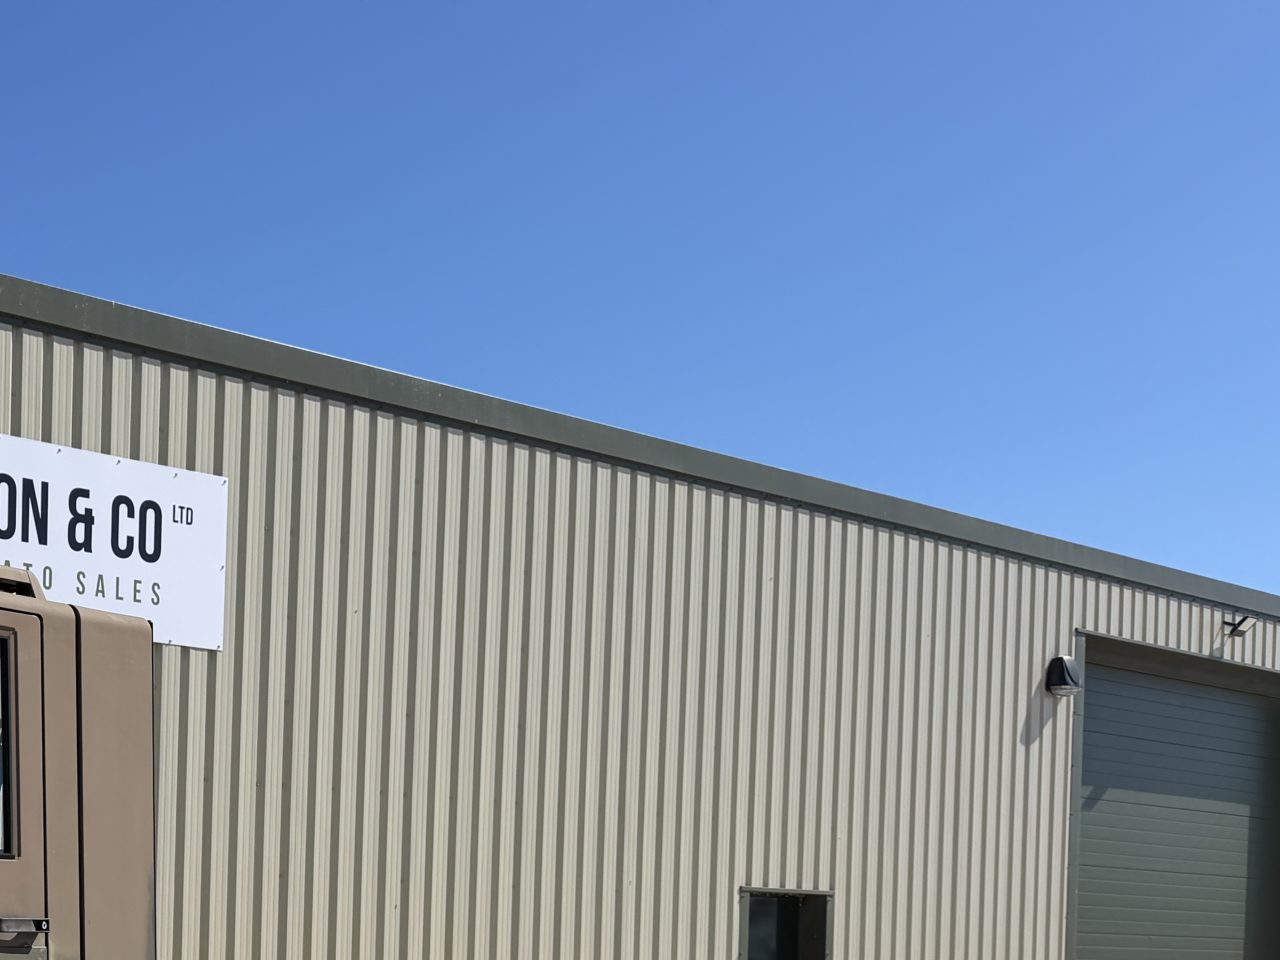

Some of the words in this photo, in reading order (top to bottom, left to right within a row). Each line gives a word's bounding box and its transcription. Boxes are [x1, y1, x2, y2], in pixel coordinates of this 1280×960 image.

[67, 487, 95, 553] &
[110, 494, 163, 564] CO
[172, 504, 194, 526] LTD
[76, 571, 161, 606] SALES
